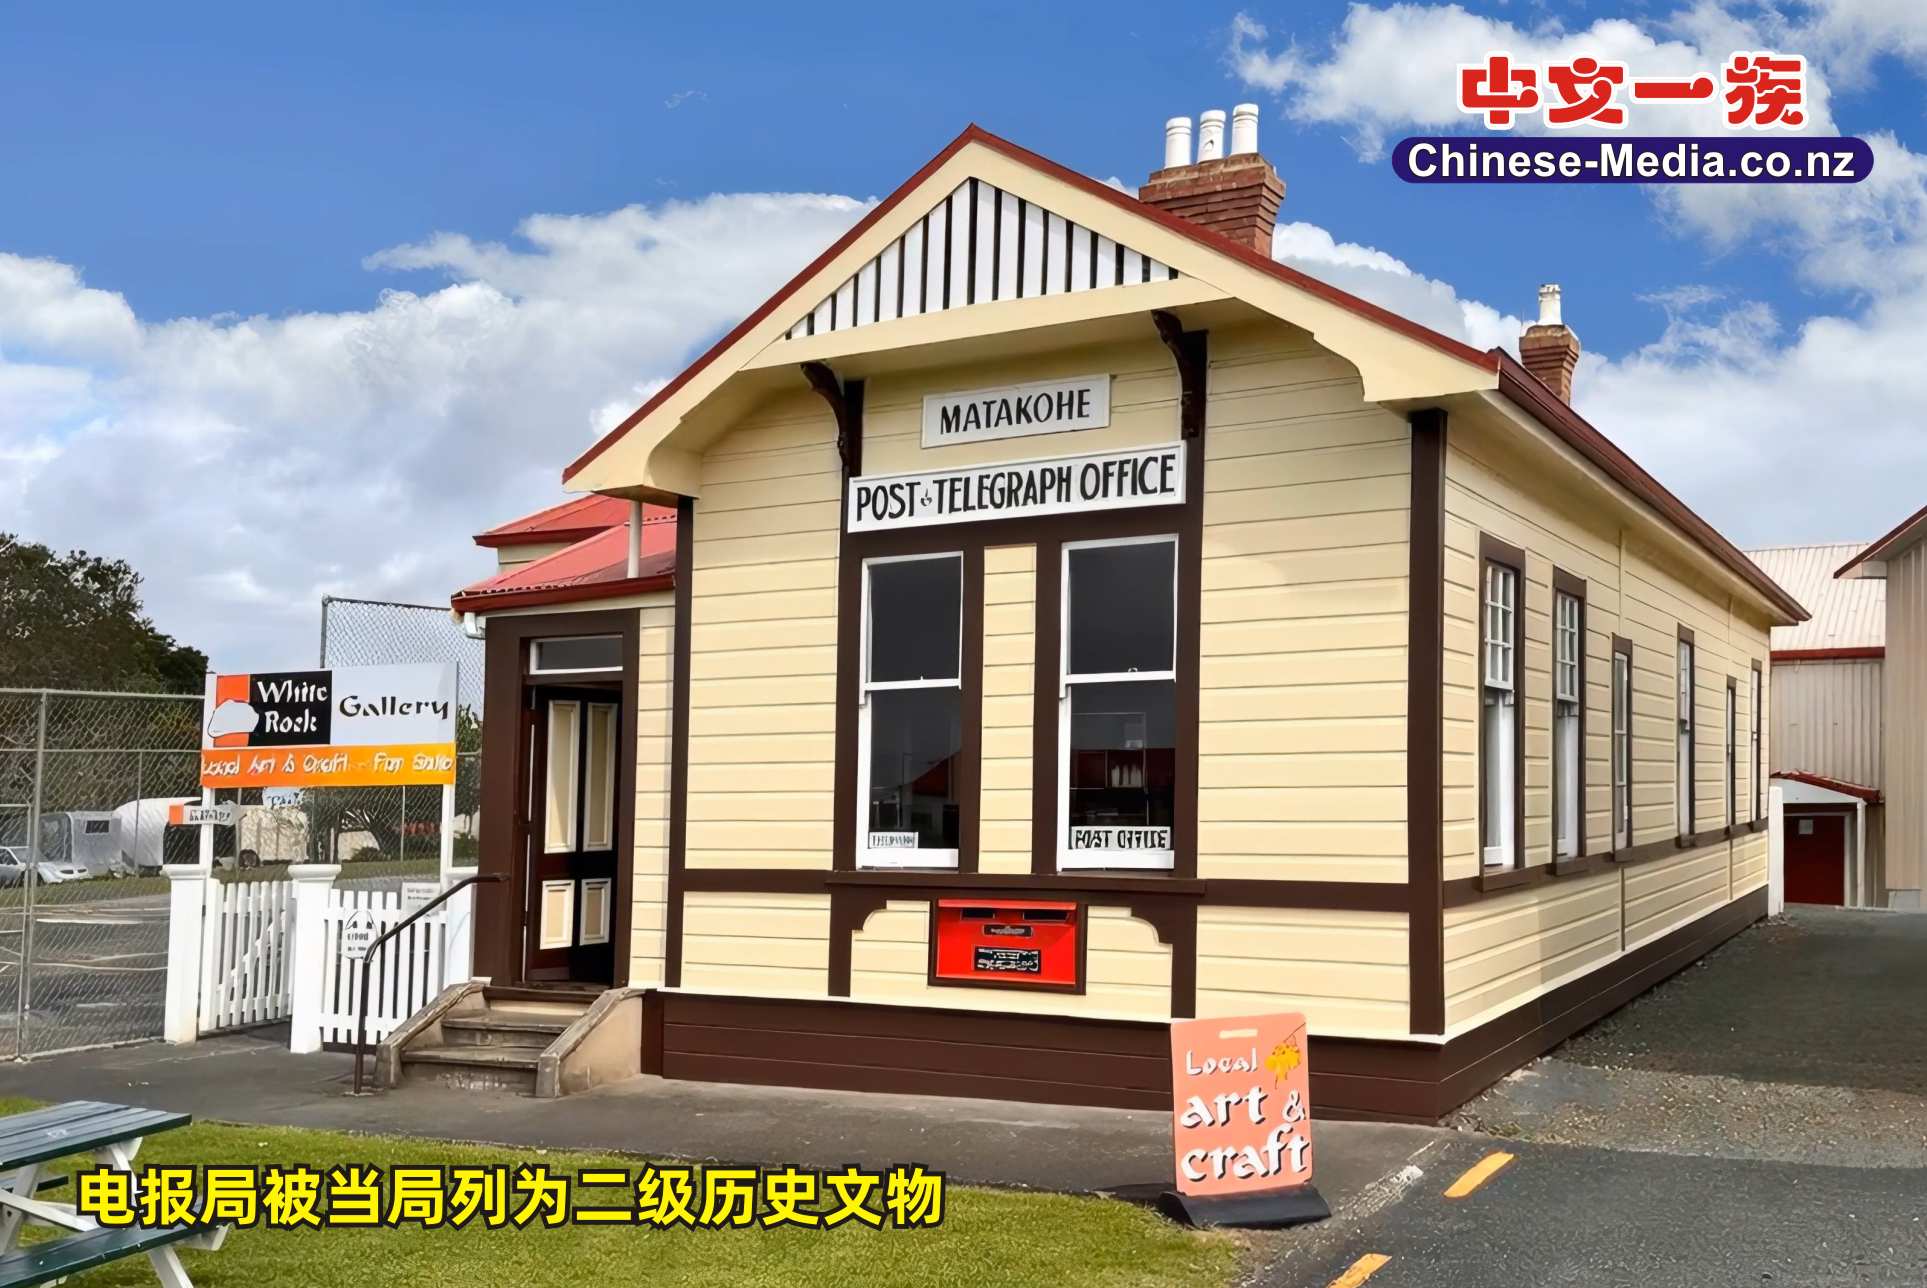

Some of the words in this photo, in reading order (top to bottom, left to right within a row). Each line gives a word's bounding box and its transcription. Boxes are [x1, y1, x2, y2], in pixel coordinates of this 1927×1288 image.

[940, 388, 1091, 435] MATAKOHE
[856, 481, 921, 522] POST
[933, 465, 1072, 514] TELEGRAPH
[1080, 454, 1177, 500] OFFICE
[257, 679, 329, 704] White
[264, 708, 318, 734] Rock
[339, 695, 449, 720] Gallery
[1075, 829, 1113, 849] POST
[1116, 829, 1168, 849] OFFICE
[1185, 1047, 1258, 1075] Local
[1180, 1085, 1268, 1128] art
[1282, 1088, 1307, 1123] &
[1180, 1123, 1310, 1182] craft
